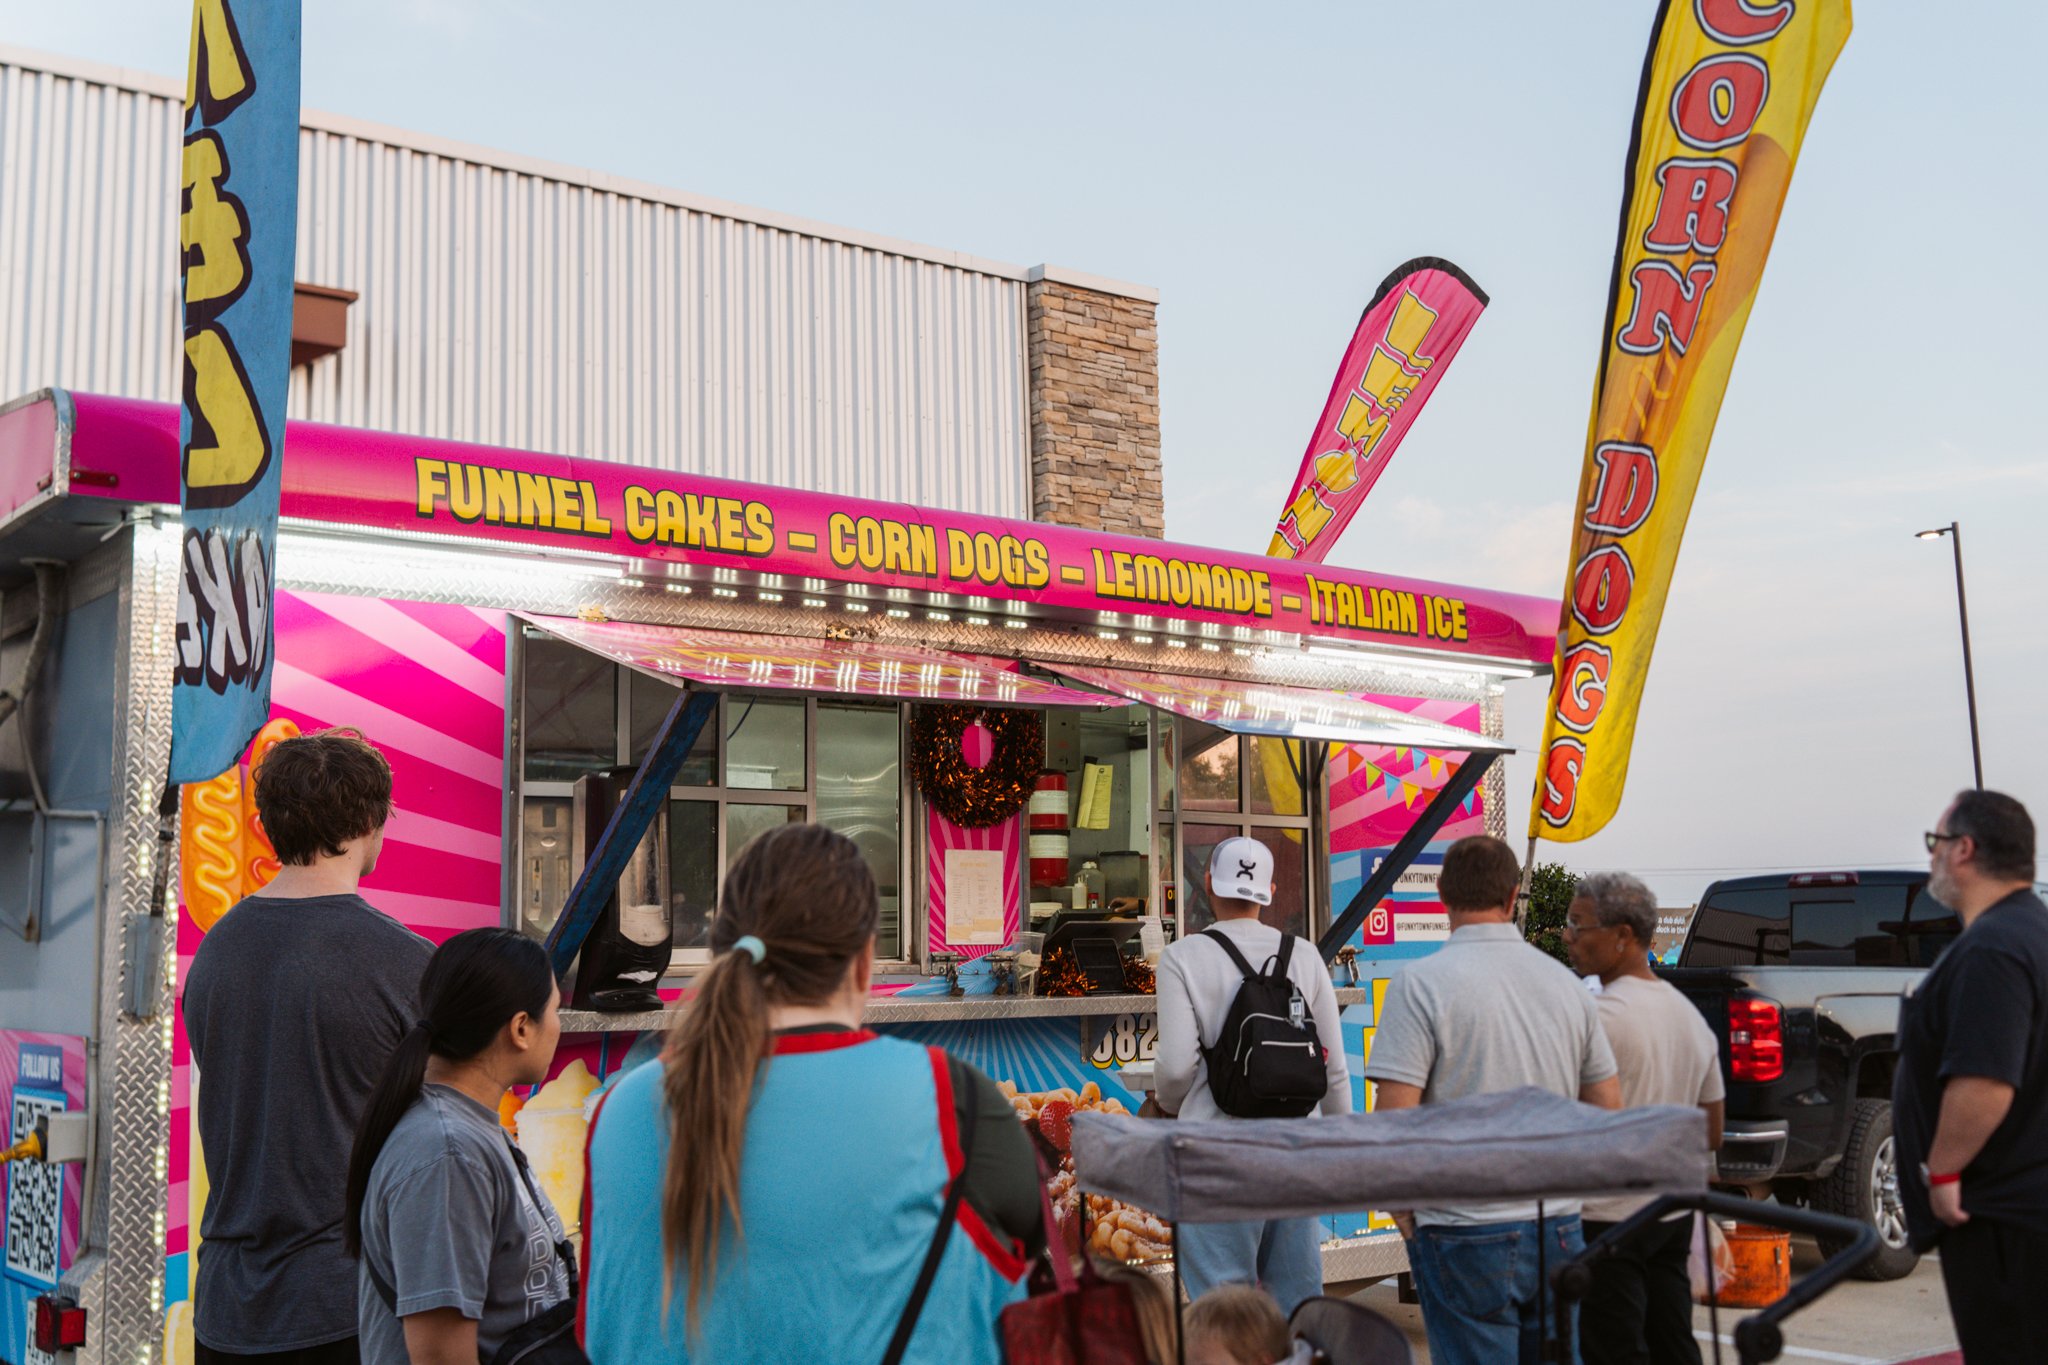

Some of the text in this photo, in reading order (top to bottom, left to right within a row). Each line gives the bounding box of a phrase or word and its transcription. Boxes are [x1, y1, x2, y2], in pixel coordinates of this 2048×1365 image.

[415, 456, 612, 540] FUNNEL
[623, 485, 775, 558] CAKES
[828, 512, 938, 578] CORN
[946, 528, 1050, 590] DOGS
[1091, 547, 1273, 618] LEMONADE
[1304, 573, 1419, 639] ITALIAN
[1425, 594, 1469, 643] ICE
[1266, 285, 1439, 560] LEMON
[1540, 440, 1660, 829] DOGS
